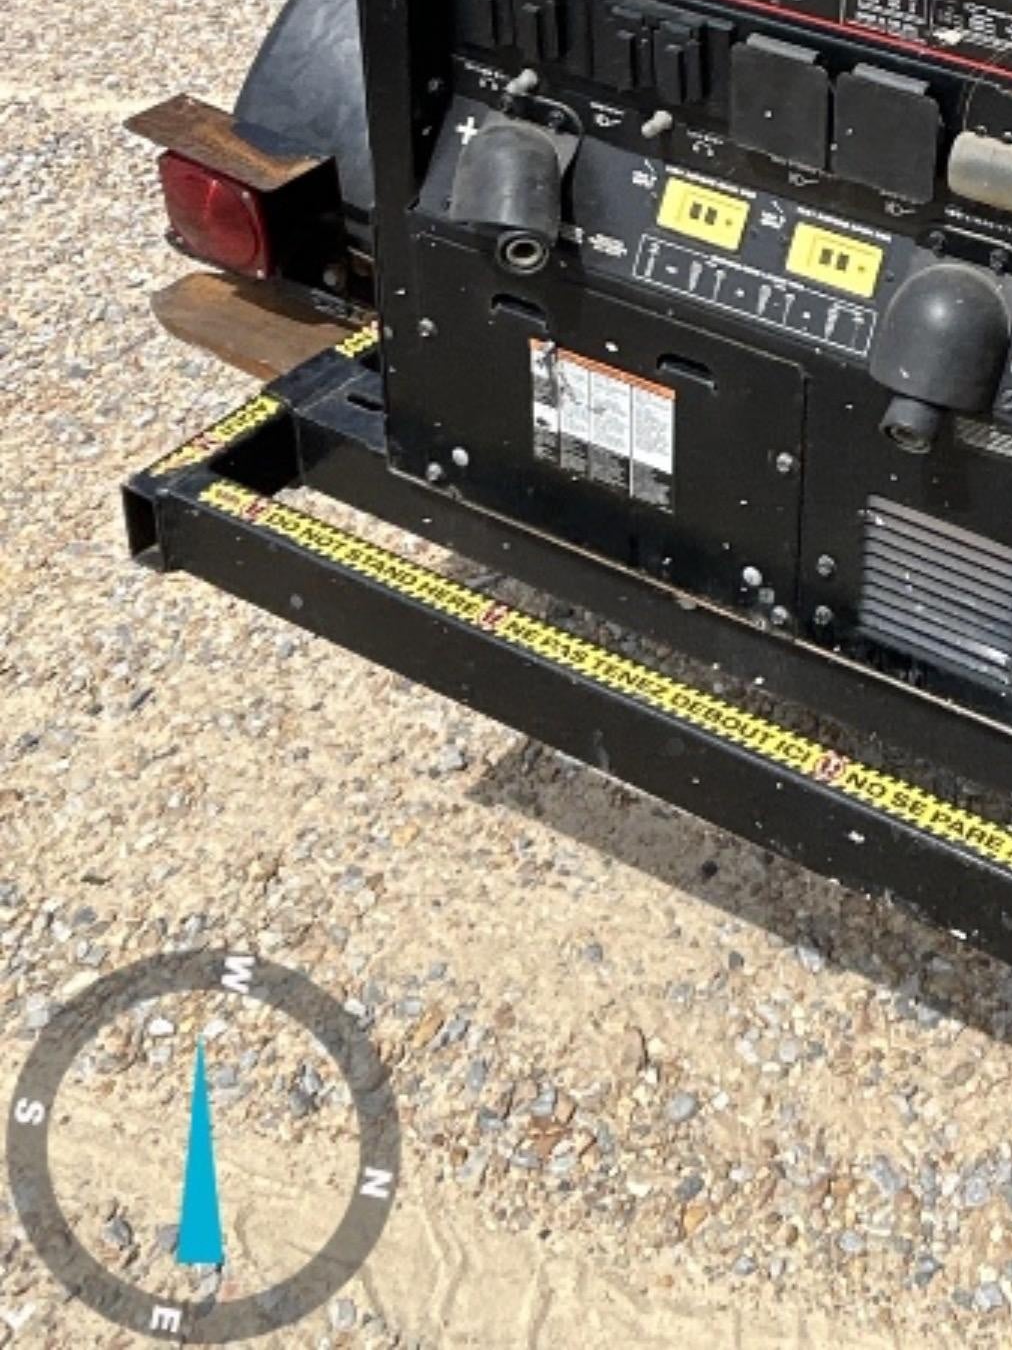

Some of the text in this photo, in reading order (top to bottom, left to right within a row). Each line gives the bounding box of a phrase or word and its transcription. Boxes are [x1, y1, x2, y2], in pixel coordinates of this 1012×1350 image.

[266, 512, 298, 532] DO
[300, 523, 346, 555] NOT
[343, 546, 417, 587] STAND
[417, 576, 481, 612] HERE
[505, 620, 536, 644] NE
[538, 634, 588, 664] PAS
[590, 653, 667, 699] TENEZ
[669, 692, 775, 745] DEBOUT
[777, 739, 813, 763] ICI
[844, 771, 887, 799] NO
[890, 790, 927, 817] SE
[929, 809, 1004, 852] PARE
